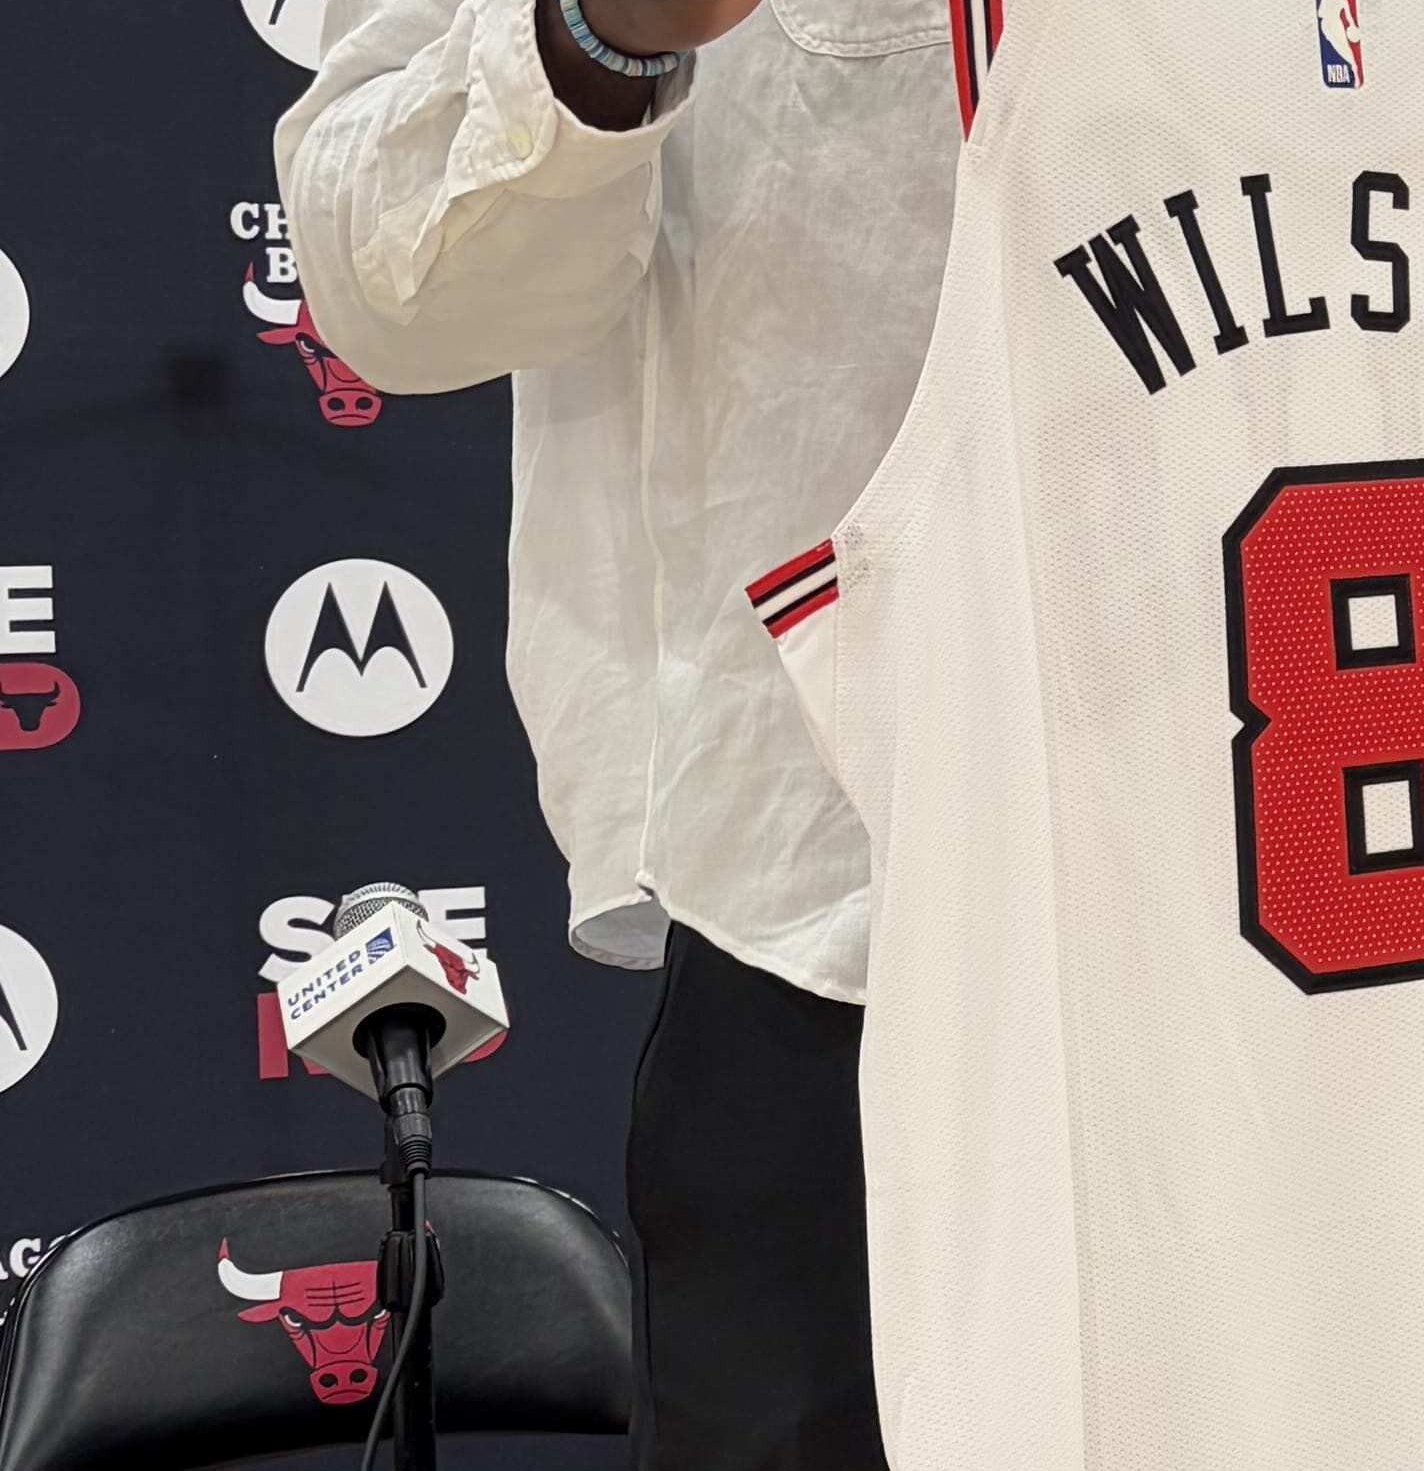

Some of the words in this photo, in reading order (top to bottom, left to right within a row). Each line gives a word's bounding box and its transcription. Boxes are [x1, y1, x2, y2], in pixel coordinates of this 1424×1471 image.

[1327, 64, 1350, 83] NBA
[258, 888, 487, 983] SE
[287, 950, 362, 1007] UNITED
[290, 963, 365, 1020] CENTER
